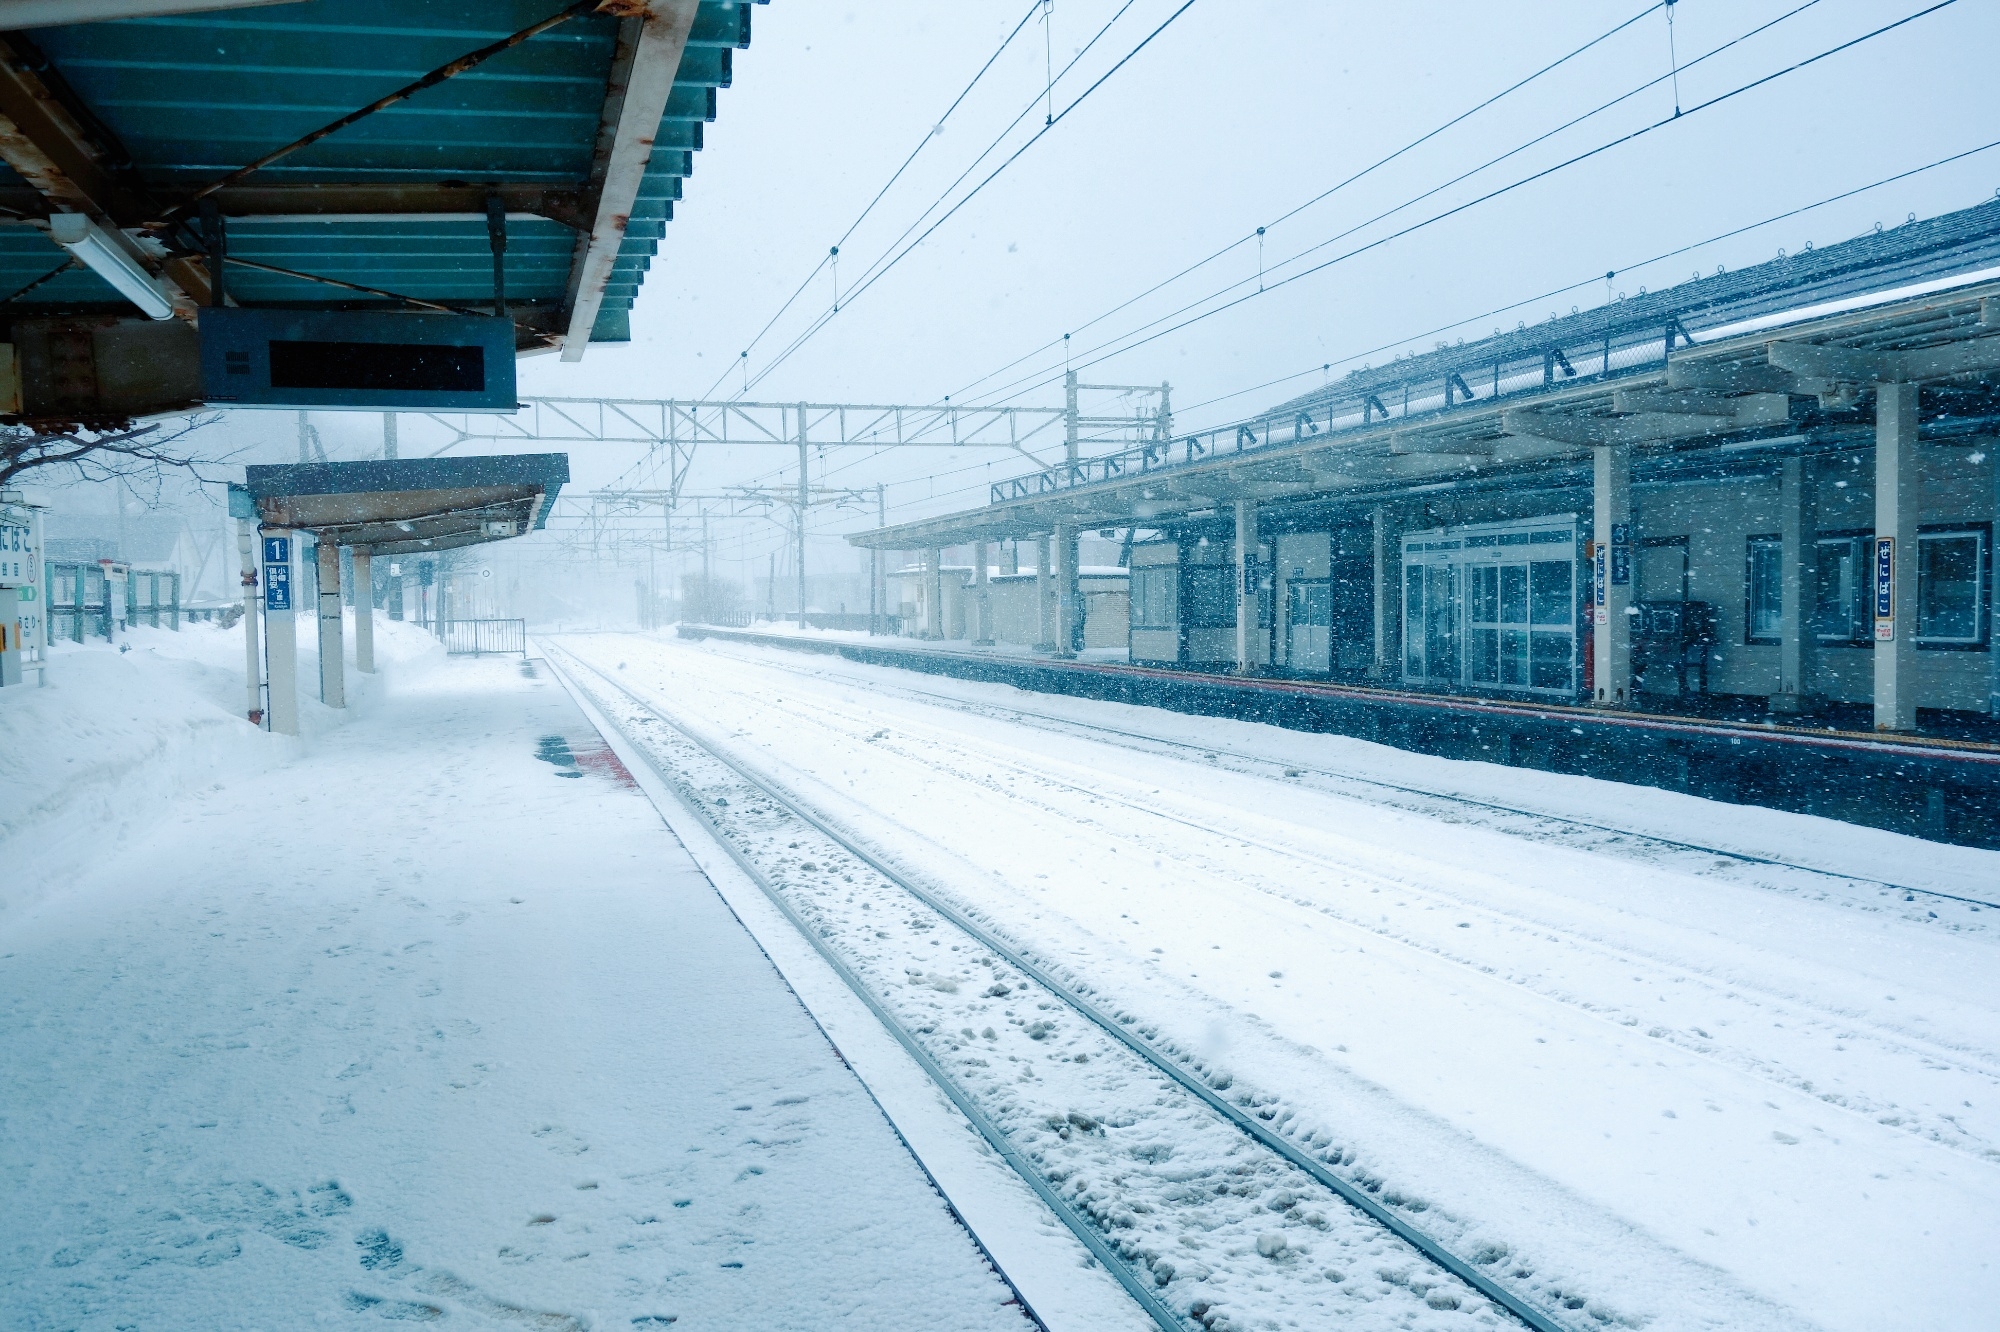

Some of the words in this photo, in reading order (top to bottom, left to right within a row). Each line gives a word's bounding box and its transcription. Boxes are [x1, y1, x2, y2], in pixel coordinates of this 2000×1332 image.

[1615, 527, 1624, 543] 3
[272, 541, 280, 559] 1
[1880, 543, 1889, 612] ぜにばこ
